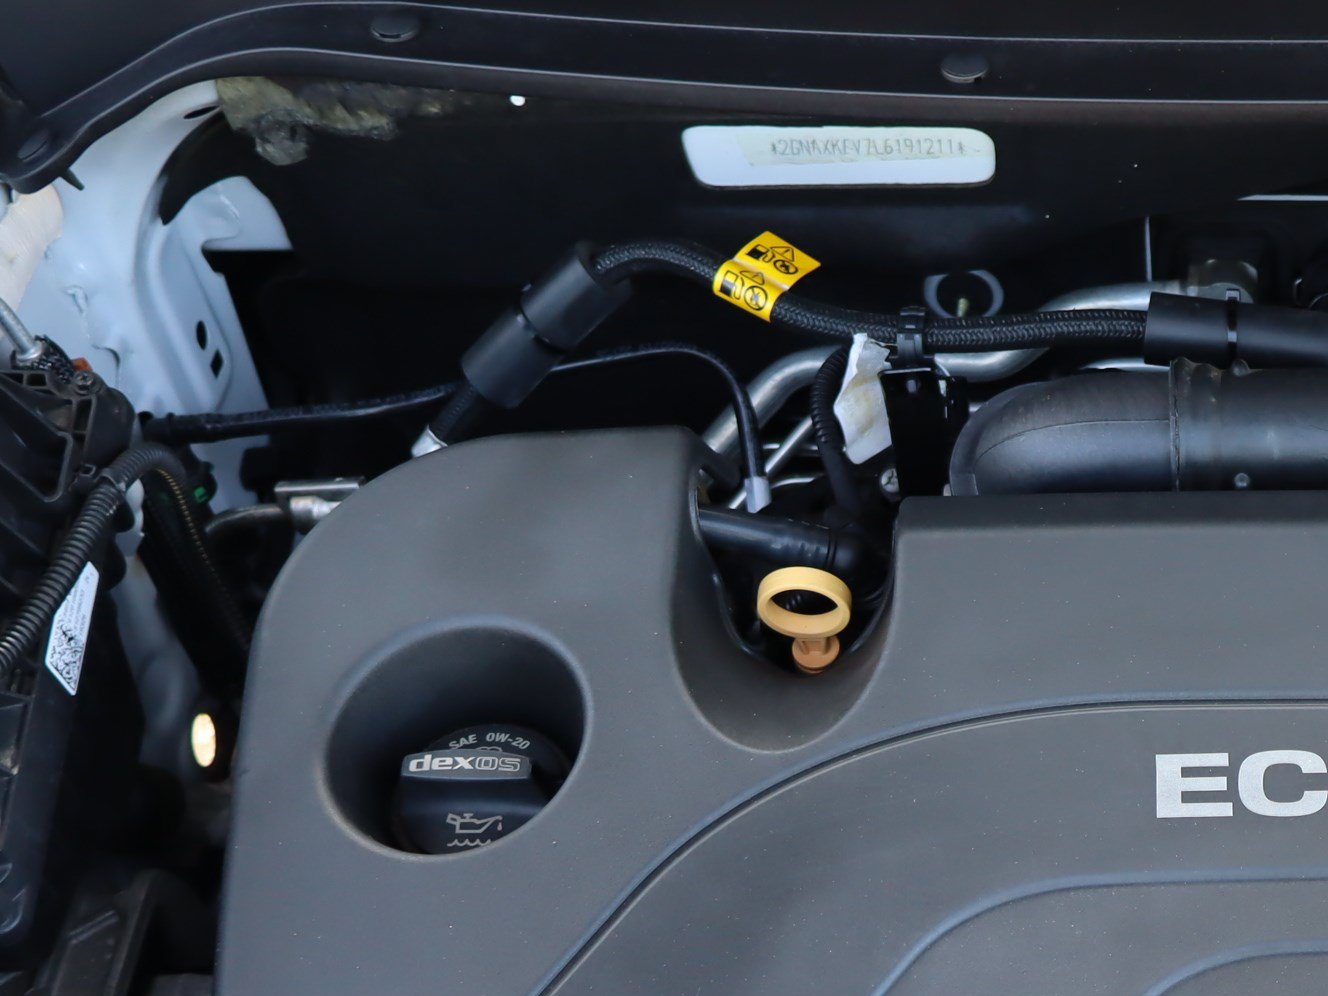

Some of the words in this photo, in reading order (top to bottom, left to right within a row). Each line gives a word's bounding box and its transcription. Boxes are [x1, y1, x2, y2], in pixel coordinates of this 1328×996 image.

[449, 734, 478, 750] SAE
[485, 732, 531, 750] 0W-20
[408, 753, 521, 773] dexos
